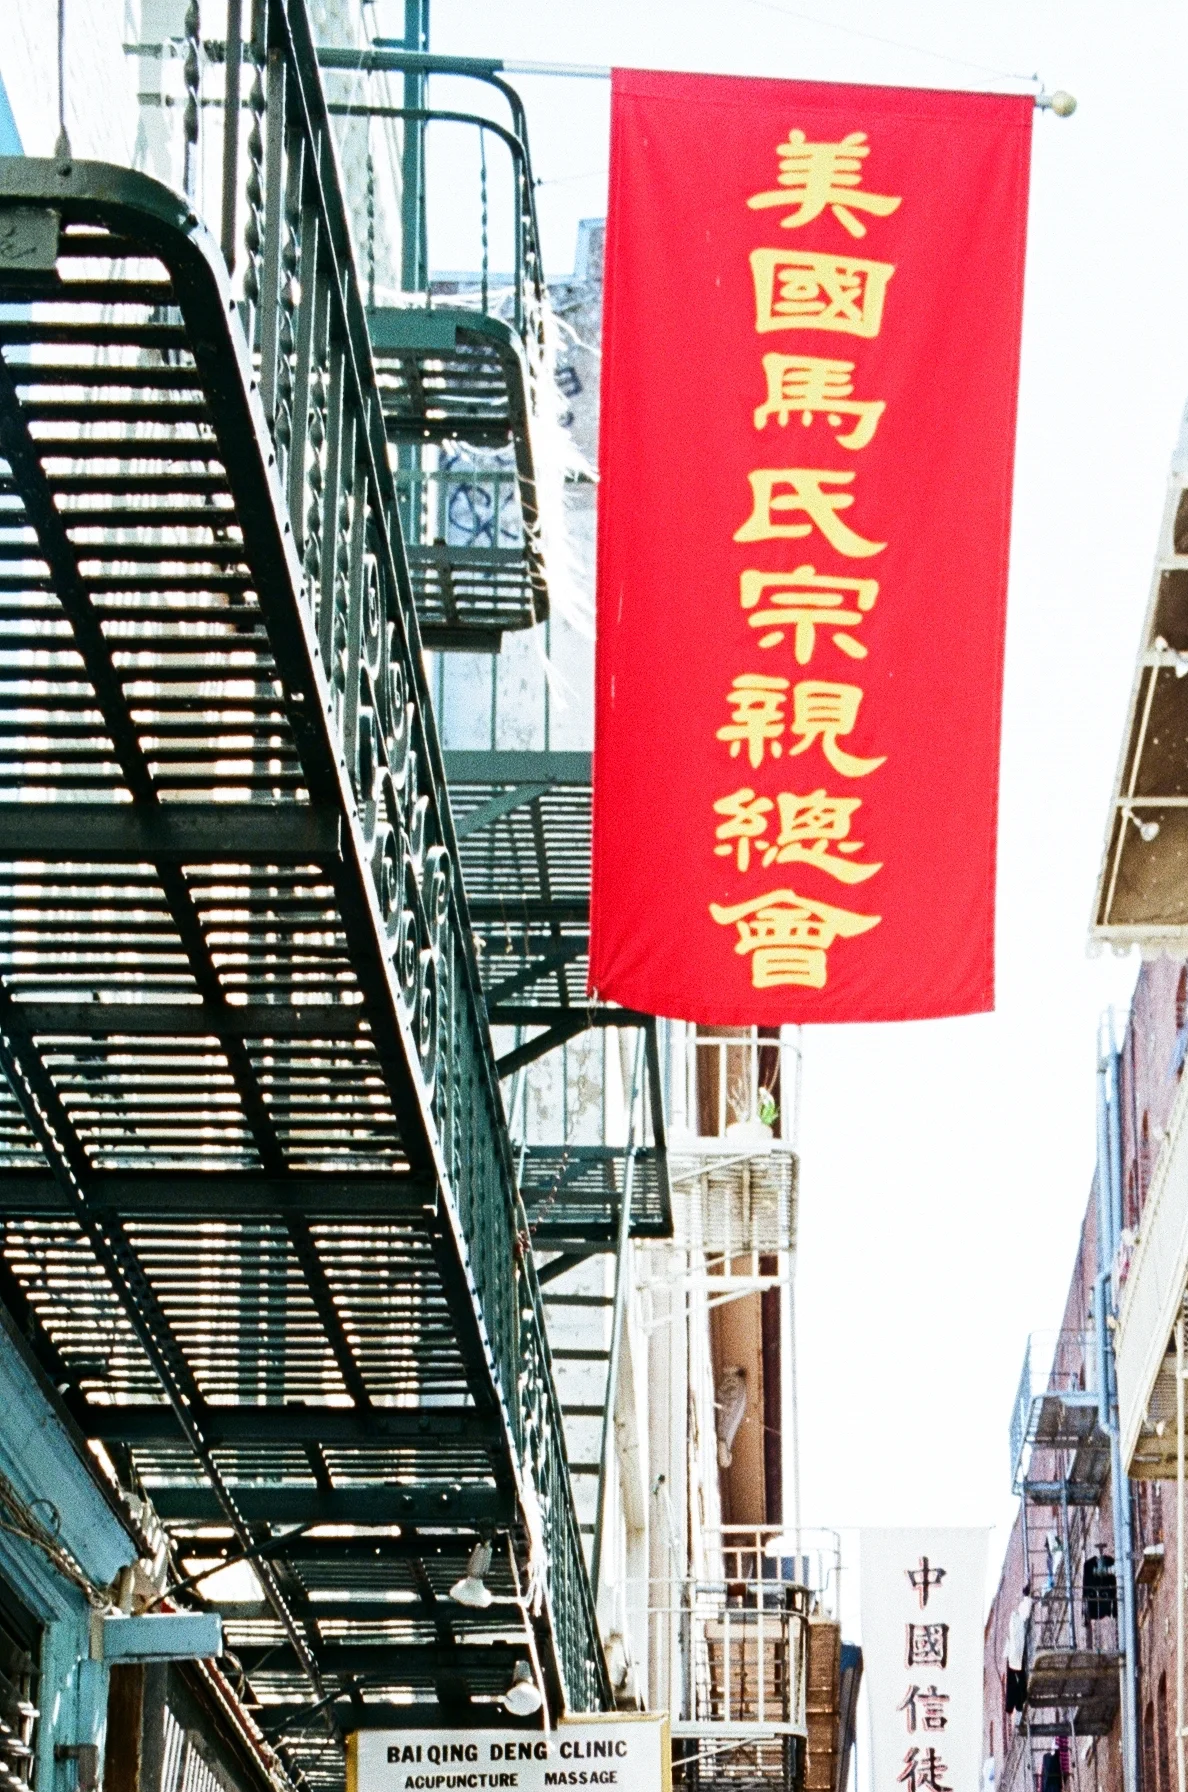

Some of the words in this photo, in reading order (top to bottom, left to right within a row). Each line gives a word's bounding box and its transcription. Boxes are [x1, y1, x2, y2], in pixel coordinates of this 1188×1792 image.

[709, 129, 903, 989] 美國馬氏宗親總會
[490, 1741, 548, 1761] DENG
[559, 1740, 628, 1759] CLINIC
[404, 1772, 519, 1790] ACUPUNCTURE
[544, 1770, 618, 1786] MASSAGE
